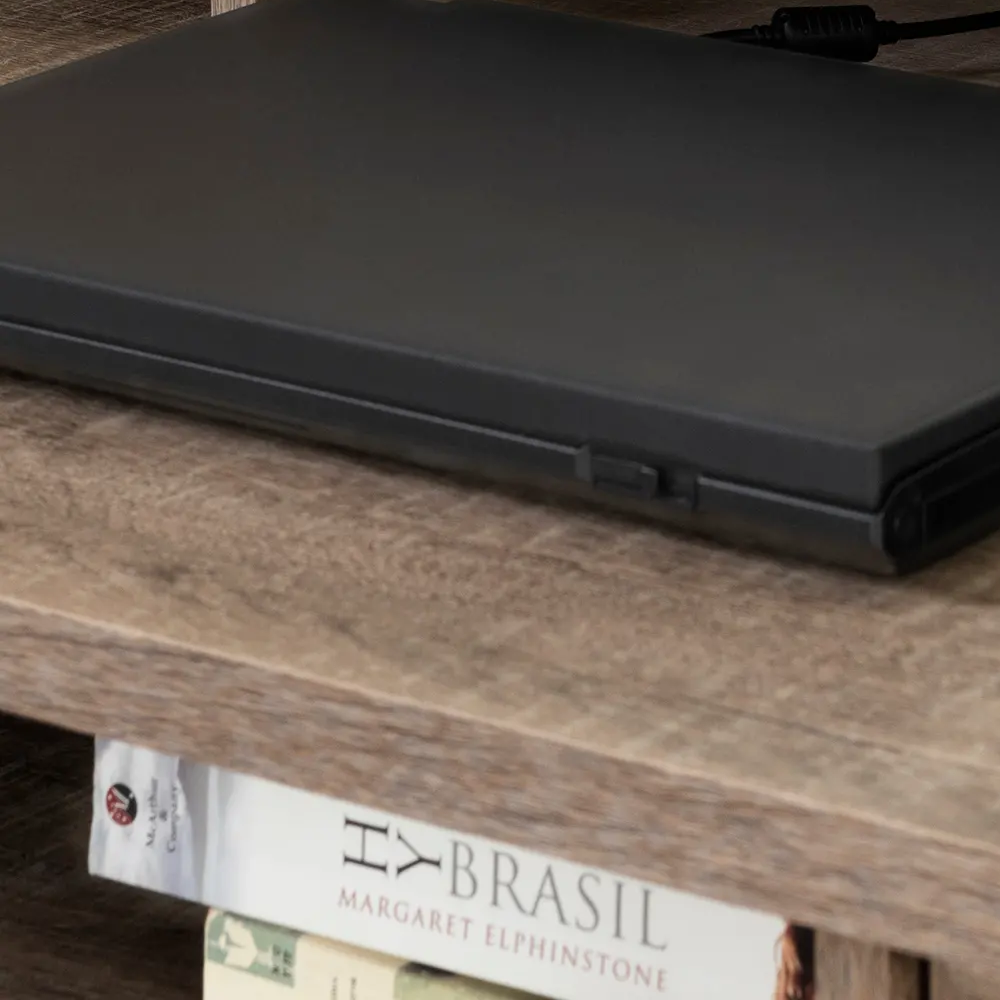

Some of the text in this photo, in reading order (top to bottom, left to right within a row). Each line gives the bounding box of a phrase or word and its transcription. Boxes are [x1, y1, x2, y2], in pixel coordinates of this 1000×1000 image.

[337, 887, 668, 992] MARGARET ELPHINSTONE
[343, 815, 668, 953] HY BRASIL
